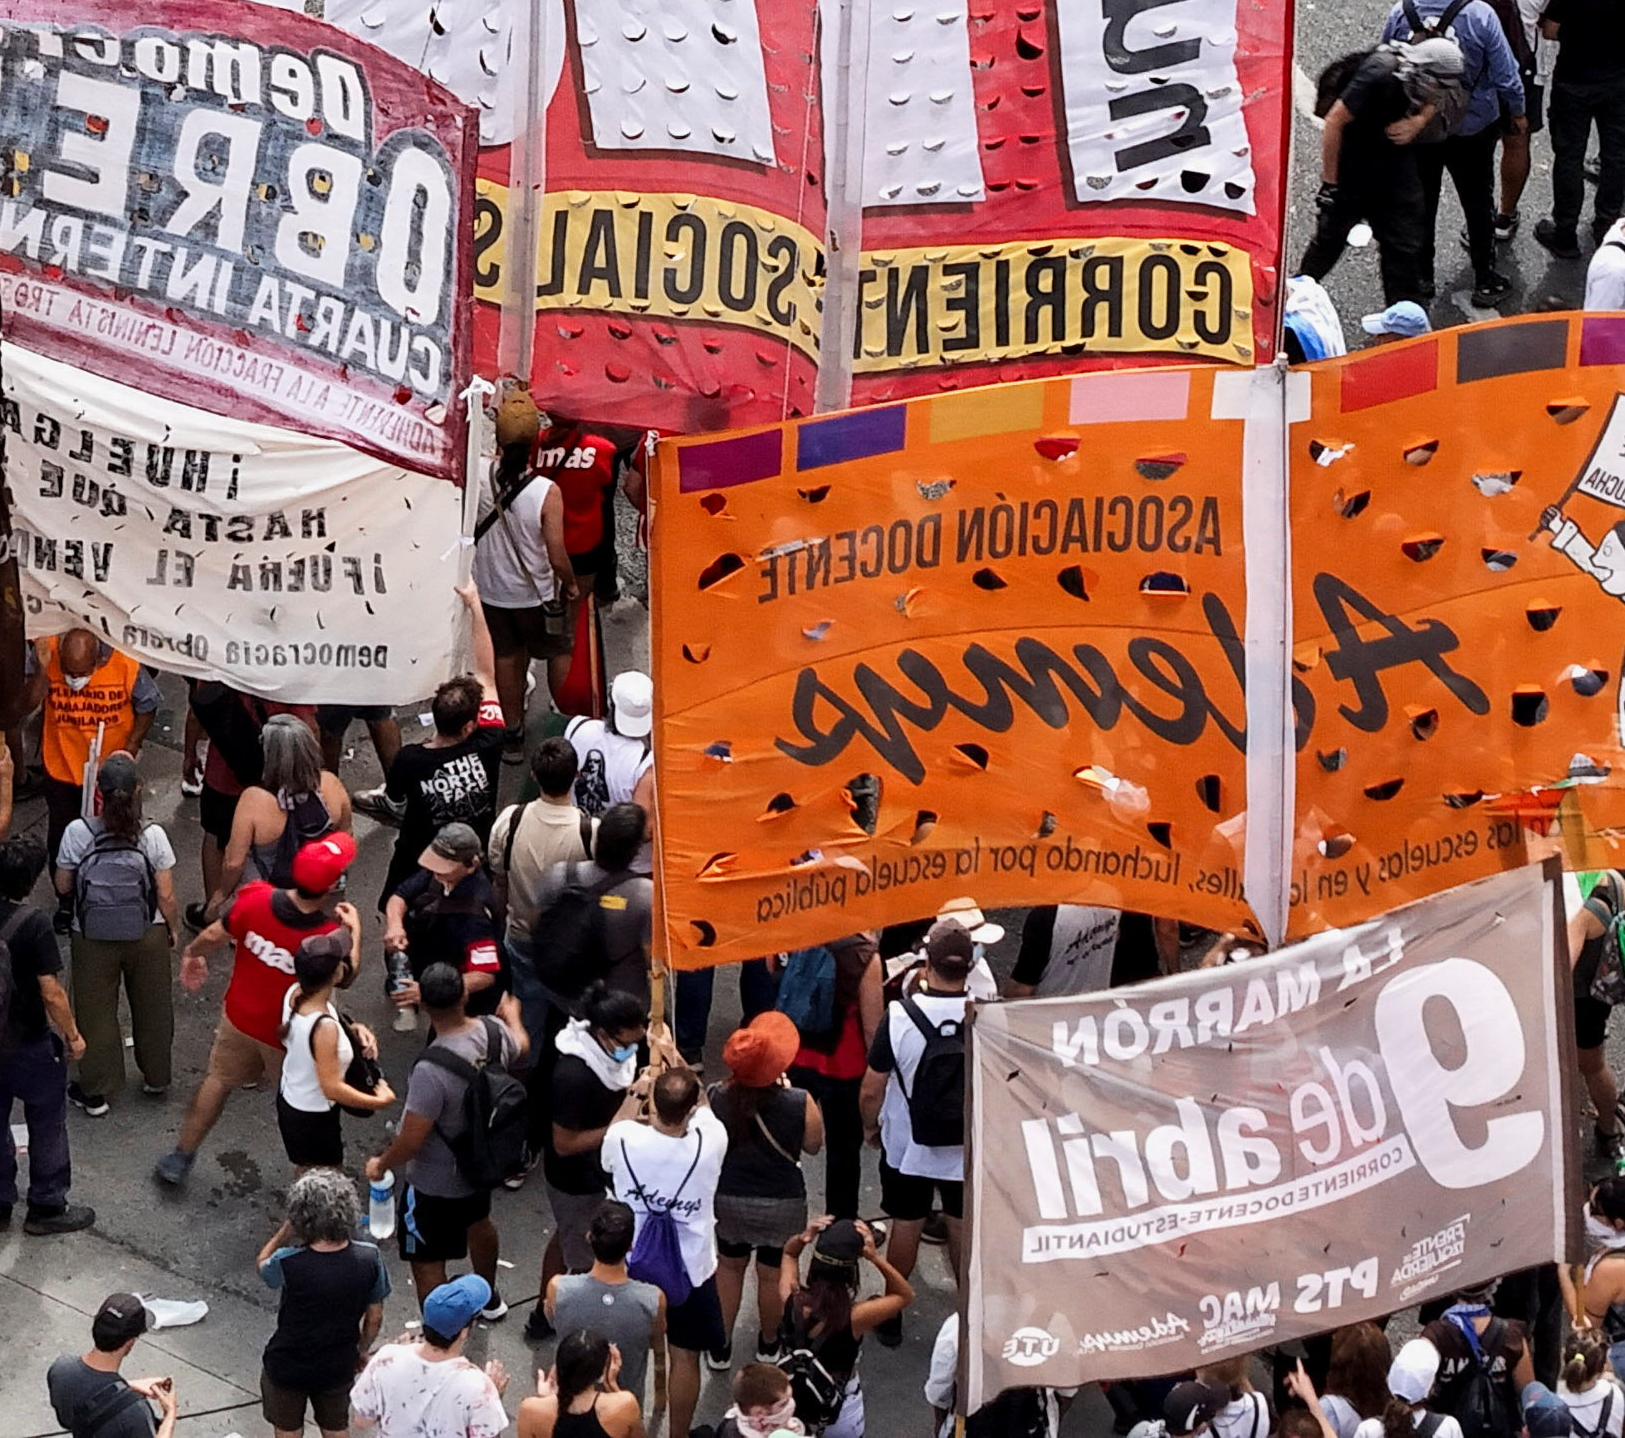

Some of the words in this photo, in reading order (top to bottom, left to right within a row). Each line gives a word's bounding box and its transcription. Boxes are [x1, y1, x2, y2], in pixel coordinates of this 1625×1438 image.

[420, 765, 487, 793] NORTH
[444, 754, 485, 773] THE
[242, 931, 298, 976] mas
[622, 1184, 703, 1218] Ademys
